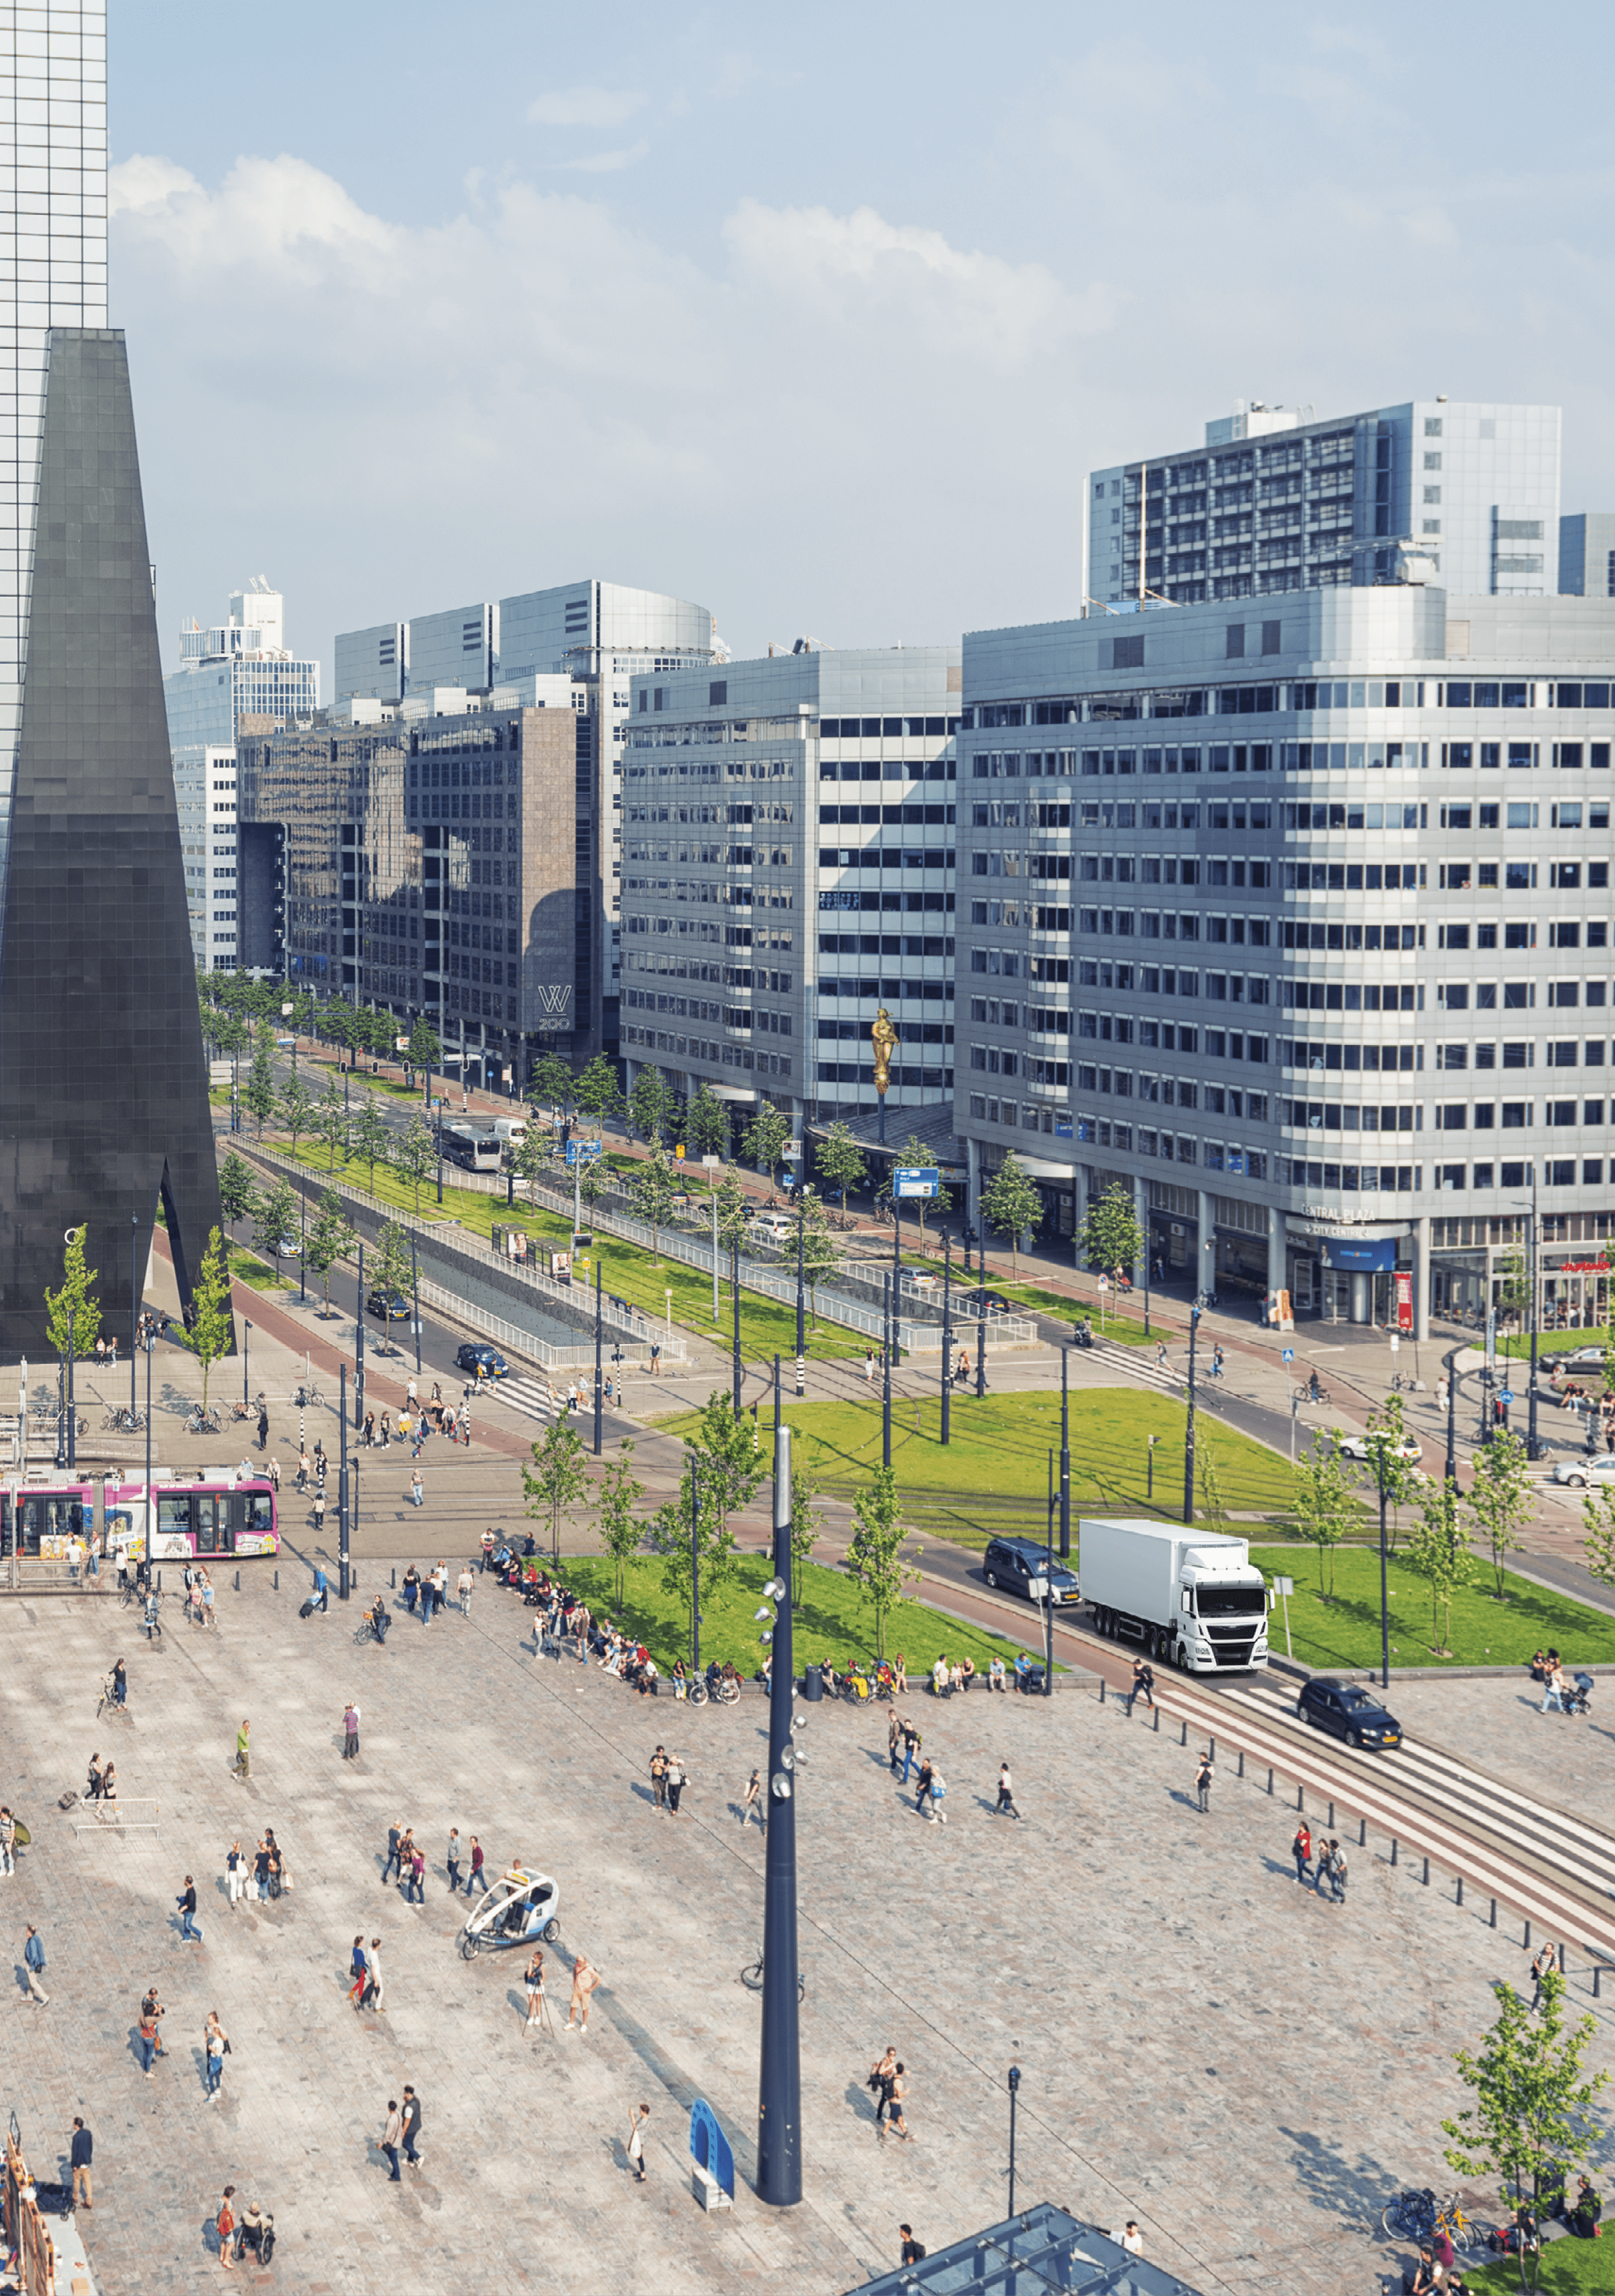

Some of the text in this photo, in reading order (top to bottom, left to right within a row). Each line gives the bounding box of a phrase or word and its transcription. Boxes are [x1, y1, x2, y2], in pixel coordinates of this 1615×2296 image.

[538, 985, 572, 1012] W
[539, 1018, 570, 1030] 200
[1301, 1204, 1376, 1221] CENTRAL PLAZA
[1313, 1225, 1360, 1237] CITY CENTRE
